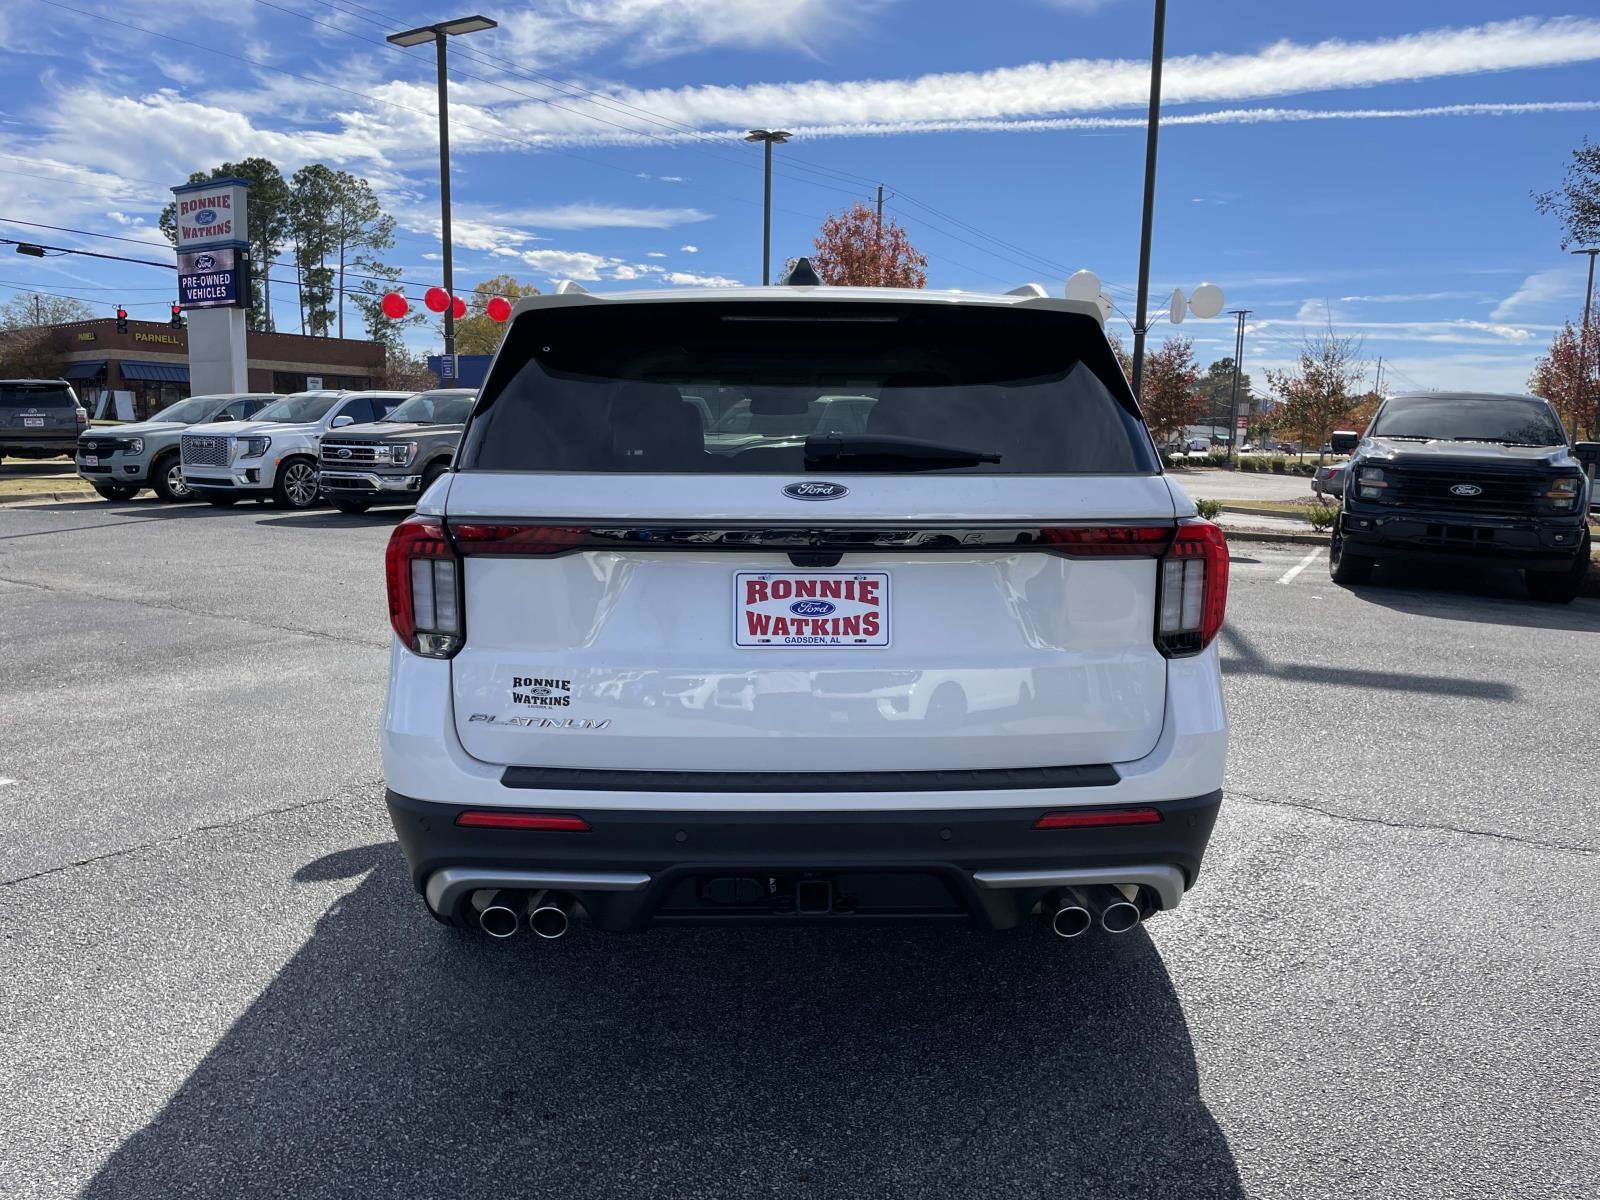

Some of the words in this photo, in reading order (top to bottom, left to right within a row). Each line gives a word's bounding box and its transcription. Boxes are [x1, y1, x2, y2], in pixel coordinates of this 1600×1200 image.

[180, 194, 231, 216] RONNIE
[181, 220, 232, 240] WATKINS
[182, 273, 231, 288] PRE-OWNED
[187, 286, 227, 300] VEHICLES
[135, 332, 179, 344] PARNELL
[797, 483, 834, 495] Ford
[746, 579, 880, 607] RONNIE
[797, 602, 829, 614] Ford
[745, 610, 880, 637] WATKINS
[784, 636, 828, 645] GADSDEN,
[512, 676, 571, 692] RONNIE
[512, 691, 570, 707] WATKINS
[468, 712, 612, 730] PLATINUM
